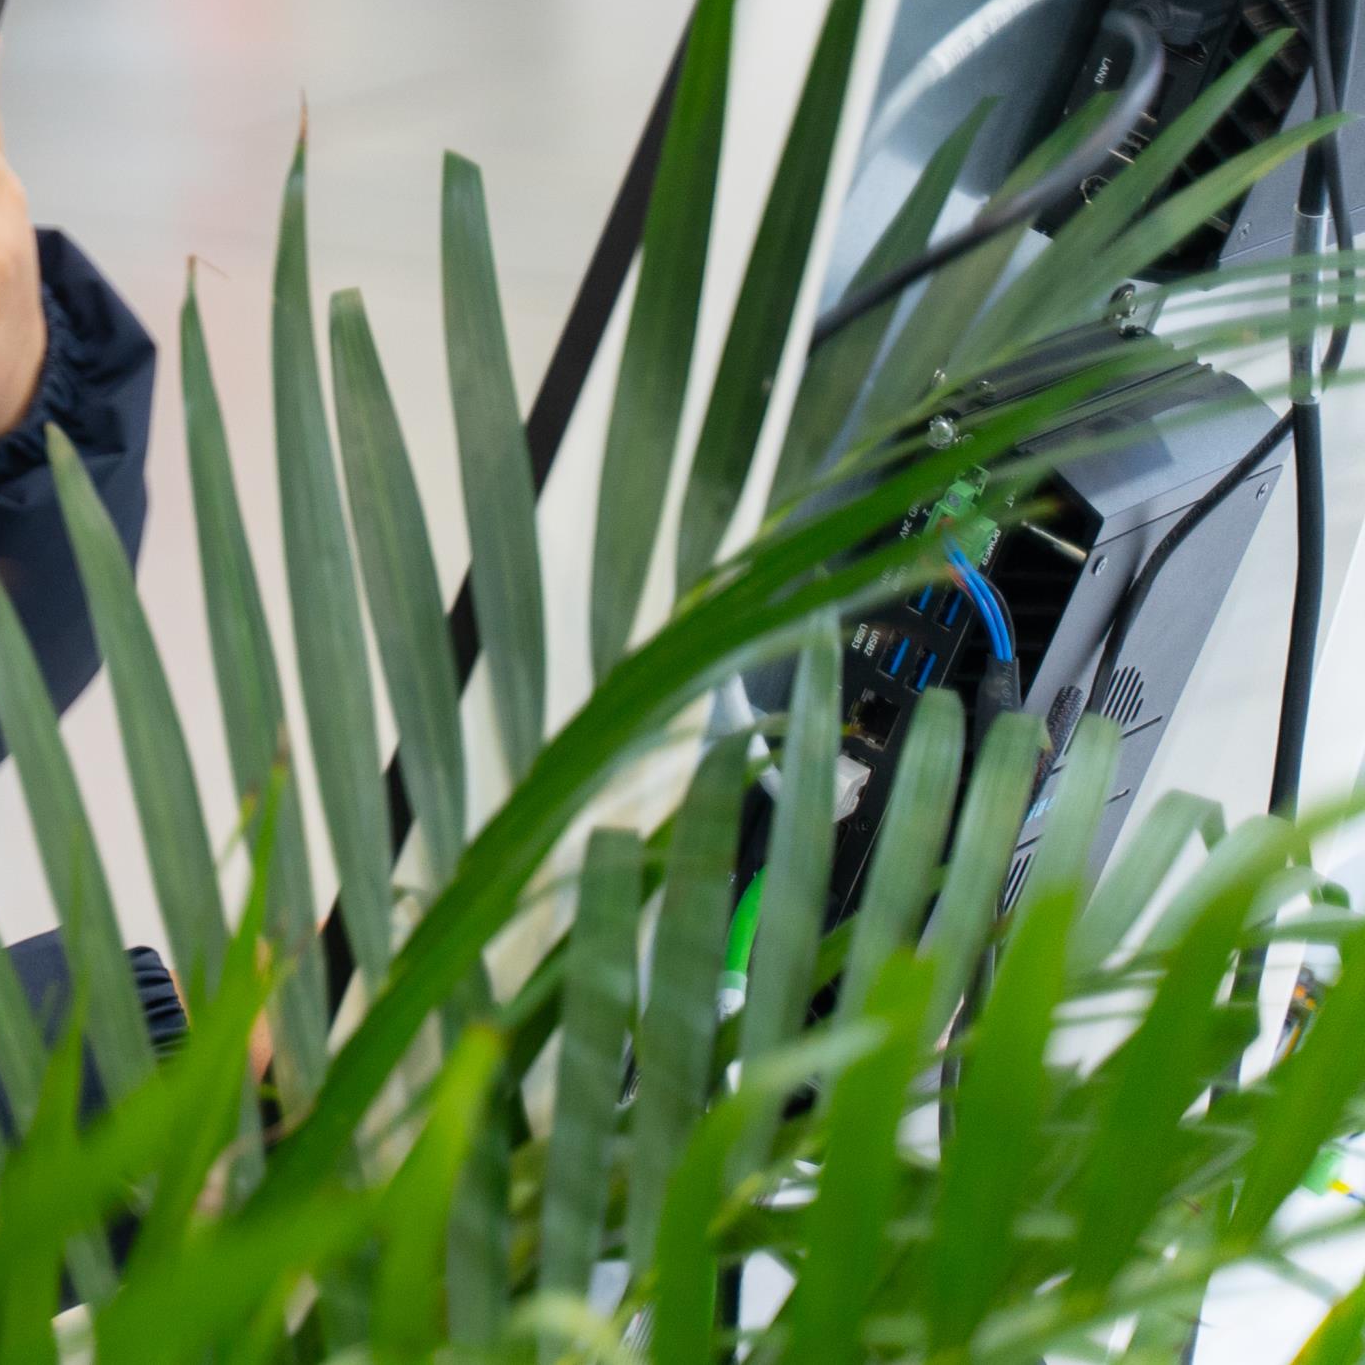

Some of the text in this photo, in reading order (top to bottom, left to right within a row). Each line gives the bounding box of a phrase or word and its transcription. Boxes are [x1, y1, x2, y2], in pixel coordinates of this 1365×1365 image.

[1093, 56, 1114, 84] LAN3
[981, 529, 1002, 566] POWER
[851, 623, 869, 649] USB3
[863, 629, 882, 656] USB2
